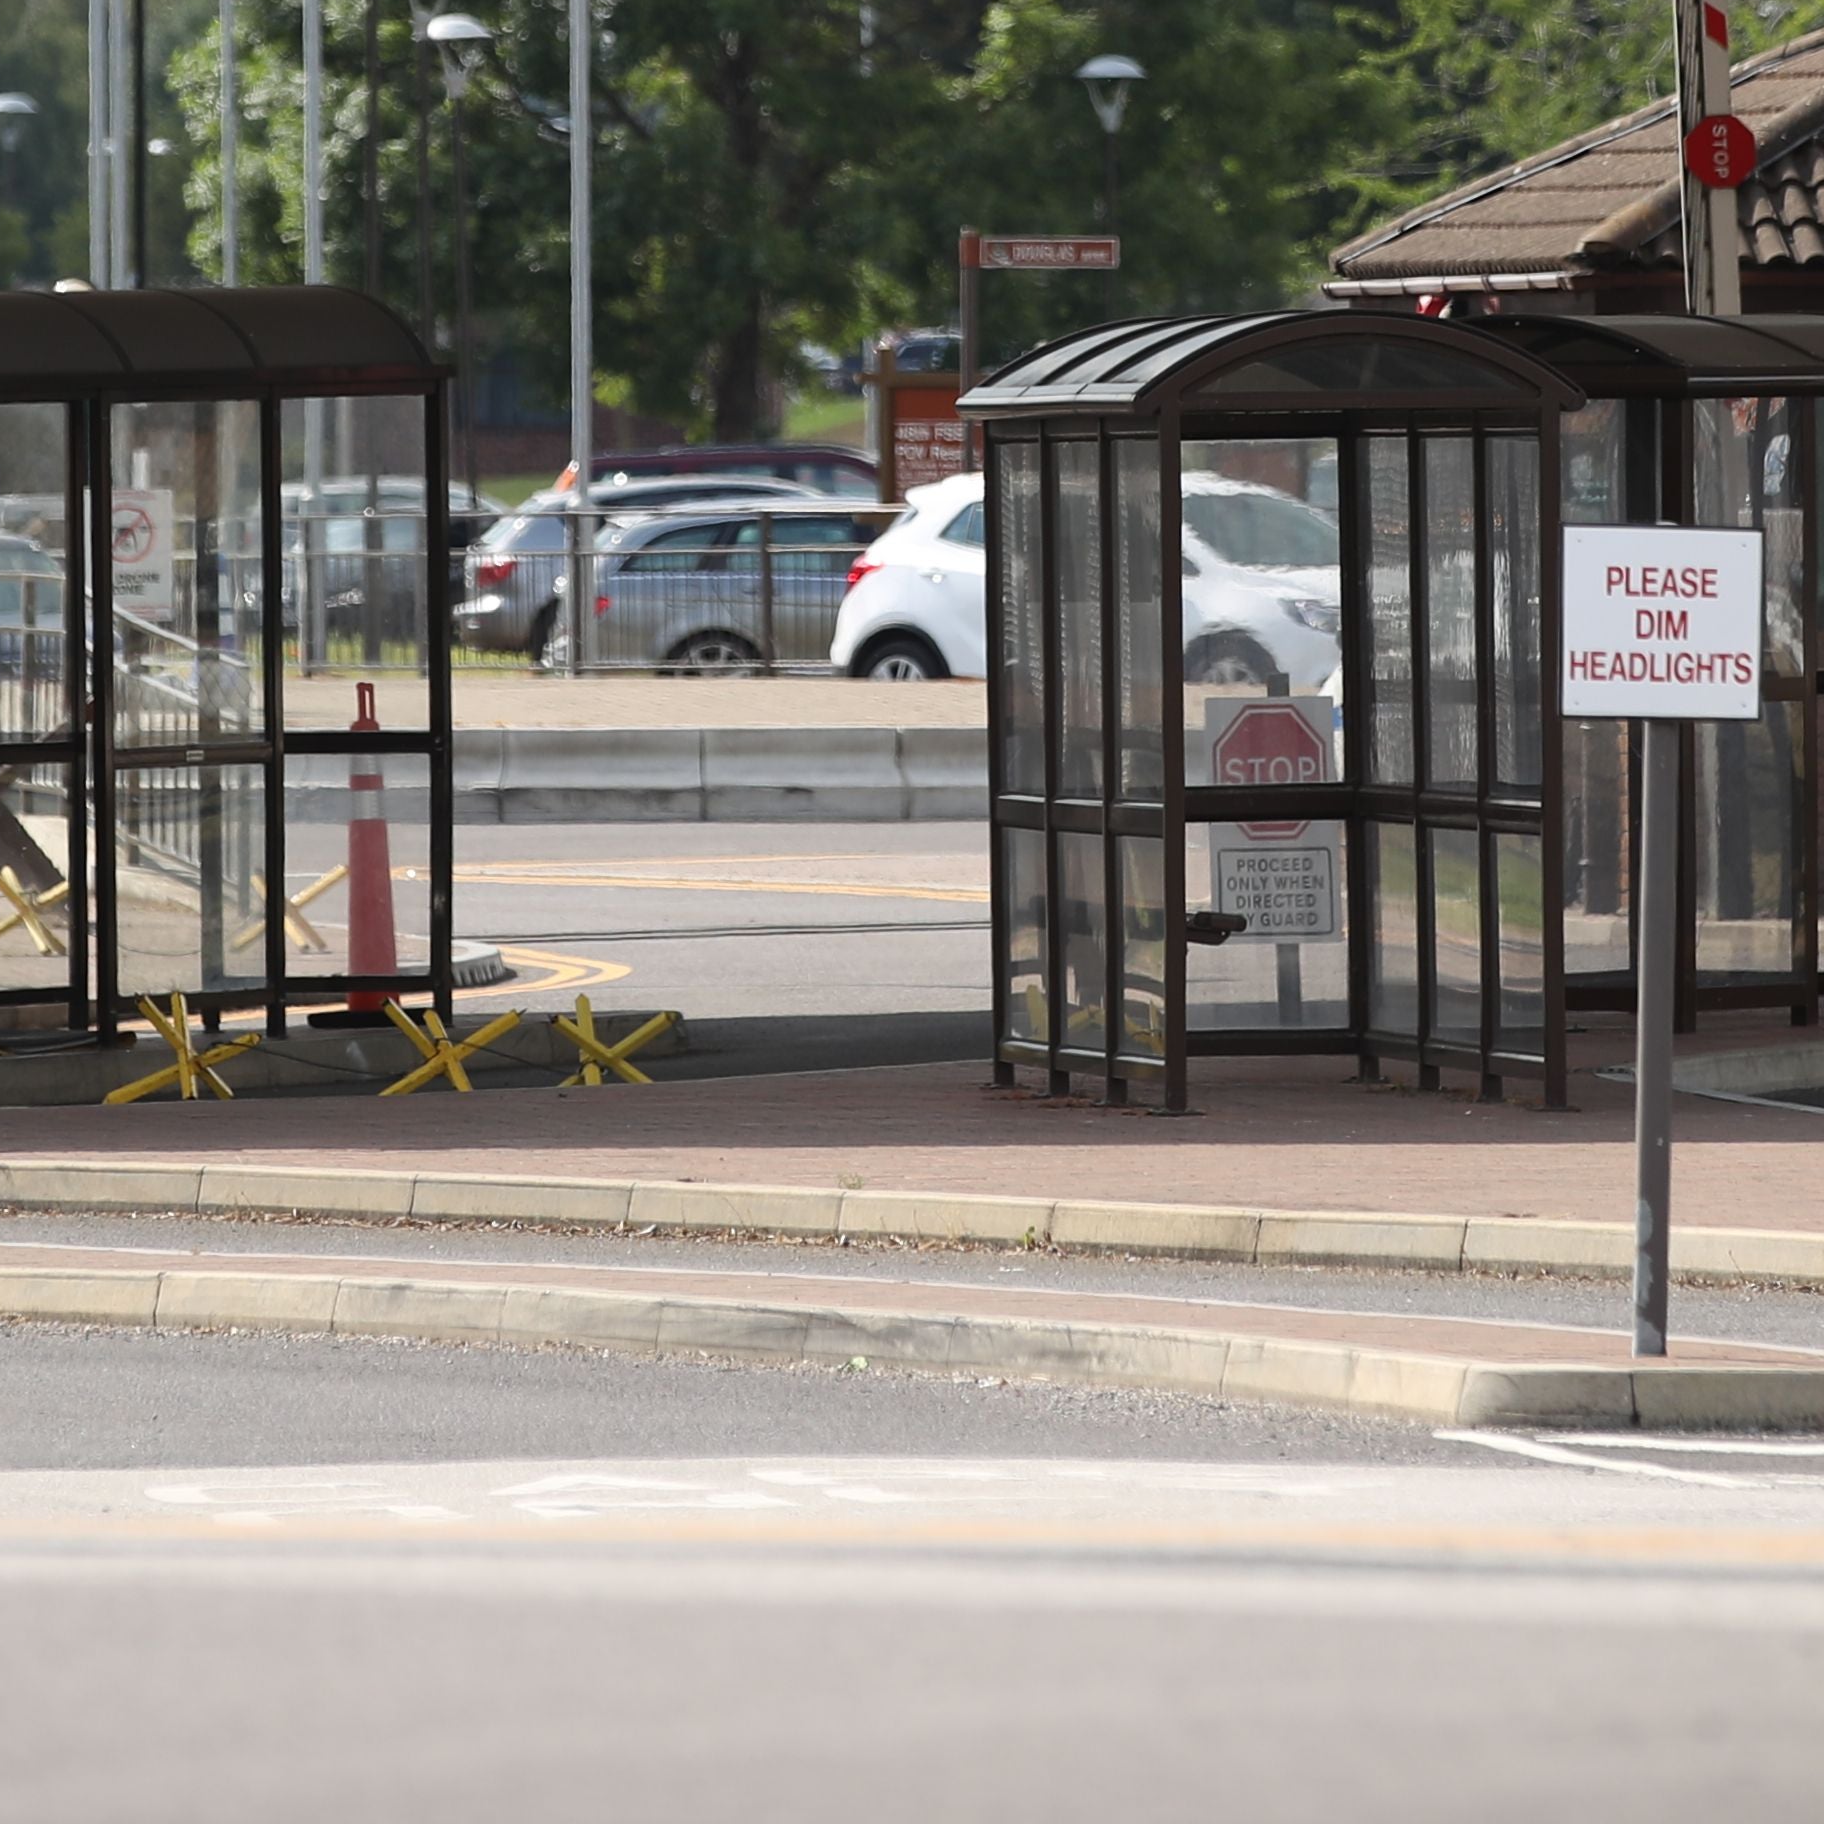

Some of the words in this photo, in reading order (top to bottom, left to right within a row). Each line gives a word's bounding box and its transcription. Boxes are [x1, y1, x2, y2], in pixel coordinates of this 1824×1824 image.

[1712, 124, 1730, 178] STOP
[1606, 566, 1718, 598] PLEASE
[1636, 609, 1688, 640] DIM
[1570, 651, 1753, 684] HEADLIGHTS
[1227, 756, 1316, 784] STOP
[1236, 857, 1313, 873] PROCEED
[1227, 876, 1268, 892] ONLY
[1273, 875, 1324, 891] WHEN
[1236, 893, 1316, 909] DIRECTED
[1260, 910, 1318, 927] GUARD
